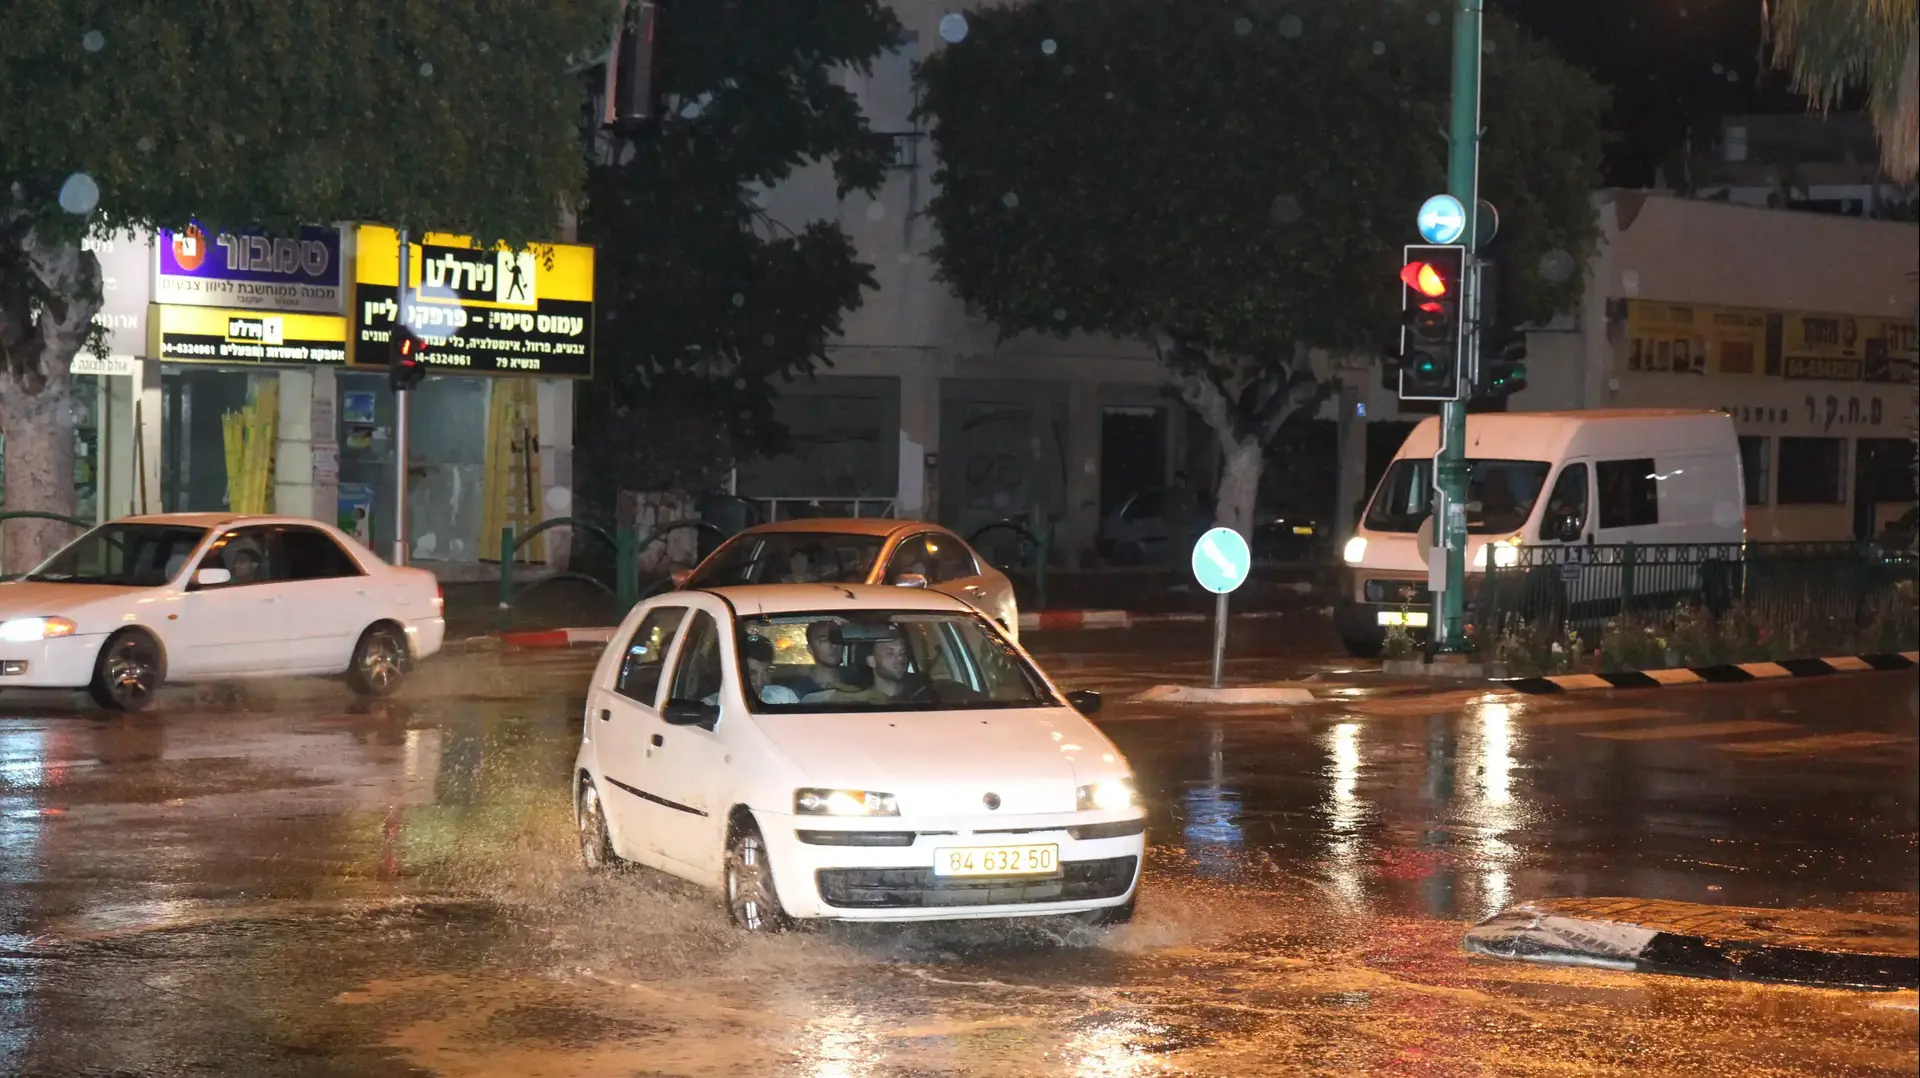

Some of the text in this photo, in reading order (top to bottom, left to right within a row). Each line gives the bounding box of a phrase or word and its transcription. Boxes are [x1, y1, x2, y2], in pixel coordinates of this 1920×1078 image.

[216, 233, 329, 277] טמבור
[425, 253, 494, 292] נירלט
[237, 281, 297, 297] ממוחשבת
[301, 286, 335, 299] מכונה
[536, 314, 584, 336] עמוס
[448, 336, 465, 349] כלי
[553, 343, 585, 355] צבעים,
[495, 357, 540, 369] הנשיא 79
[950, 849, 1051, 871] 84 632 50
